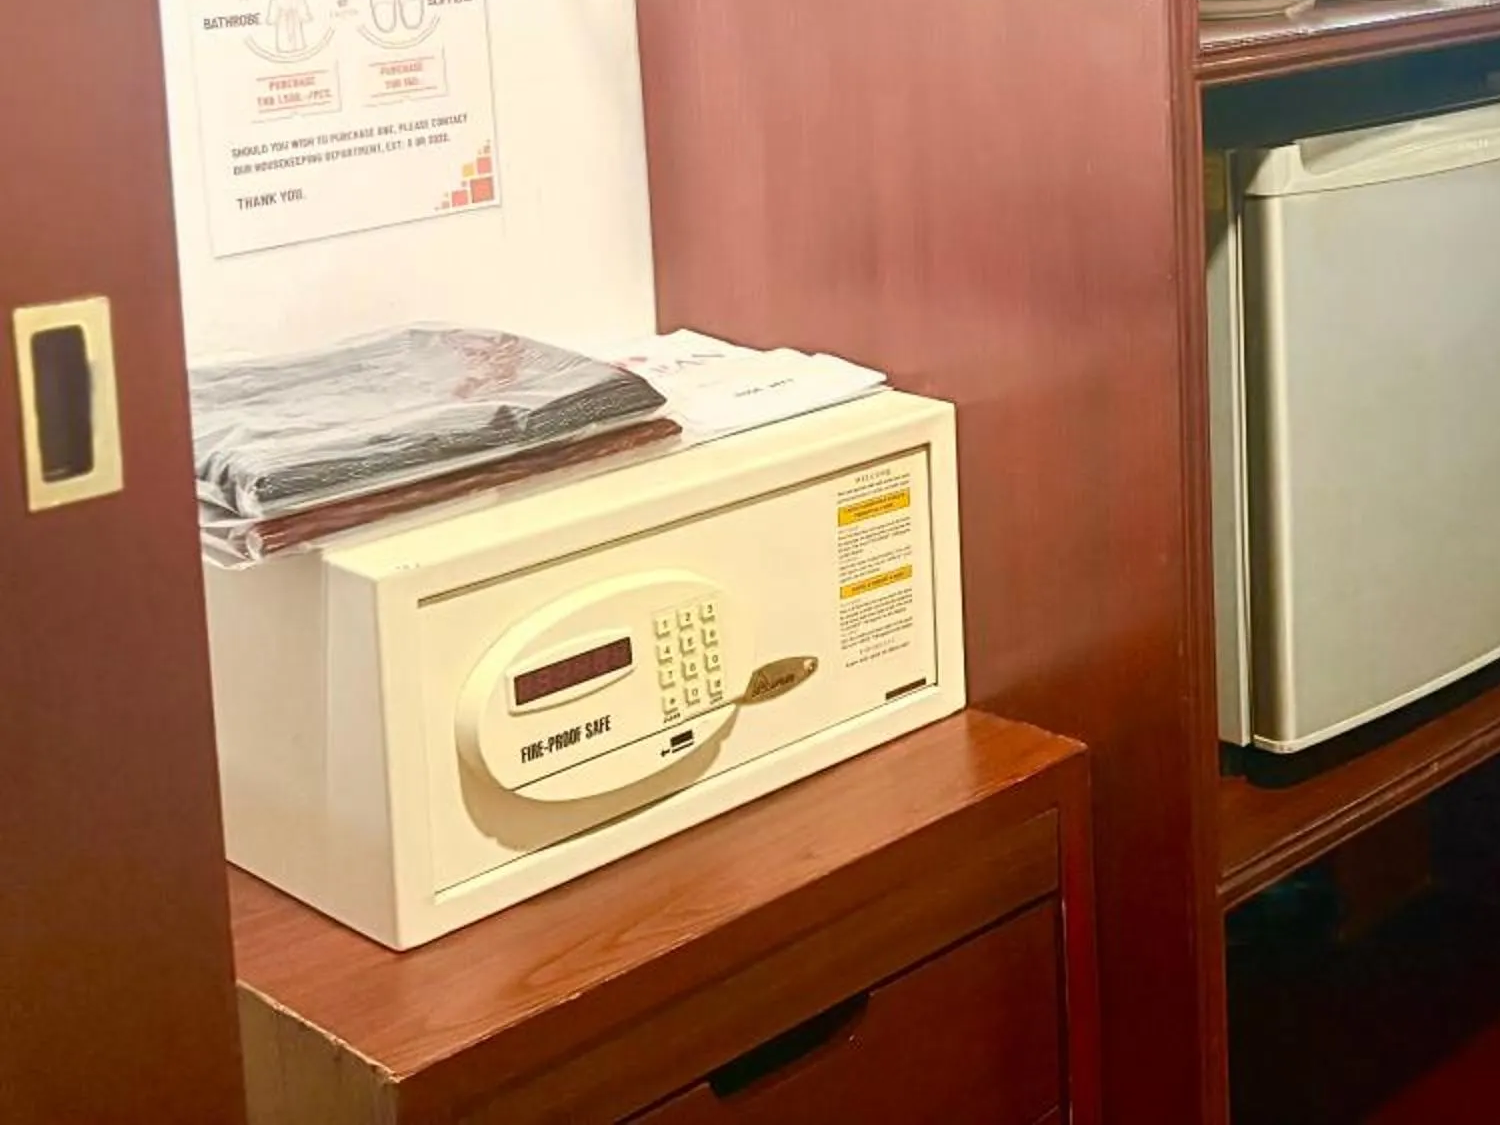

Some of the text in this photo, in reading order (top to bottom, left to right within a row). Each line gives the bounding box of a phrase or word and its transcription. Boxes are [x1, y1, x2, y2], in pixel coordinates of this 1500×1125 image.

[203, 13, 262, 30] BATHROBE
[231, 144, 268, 158] SHOULD
[270, 140, 289, 152] YOU
[291, 137, 315, 149] WISH
[236, 192, 277, 211] THANK
[520, 714, 612, 764] FIRE-PROOF SAFE
